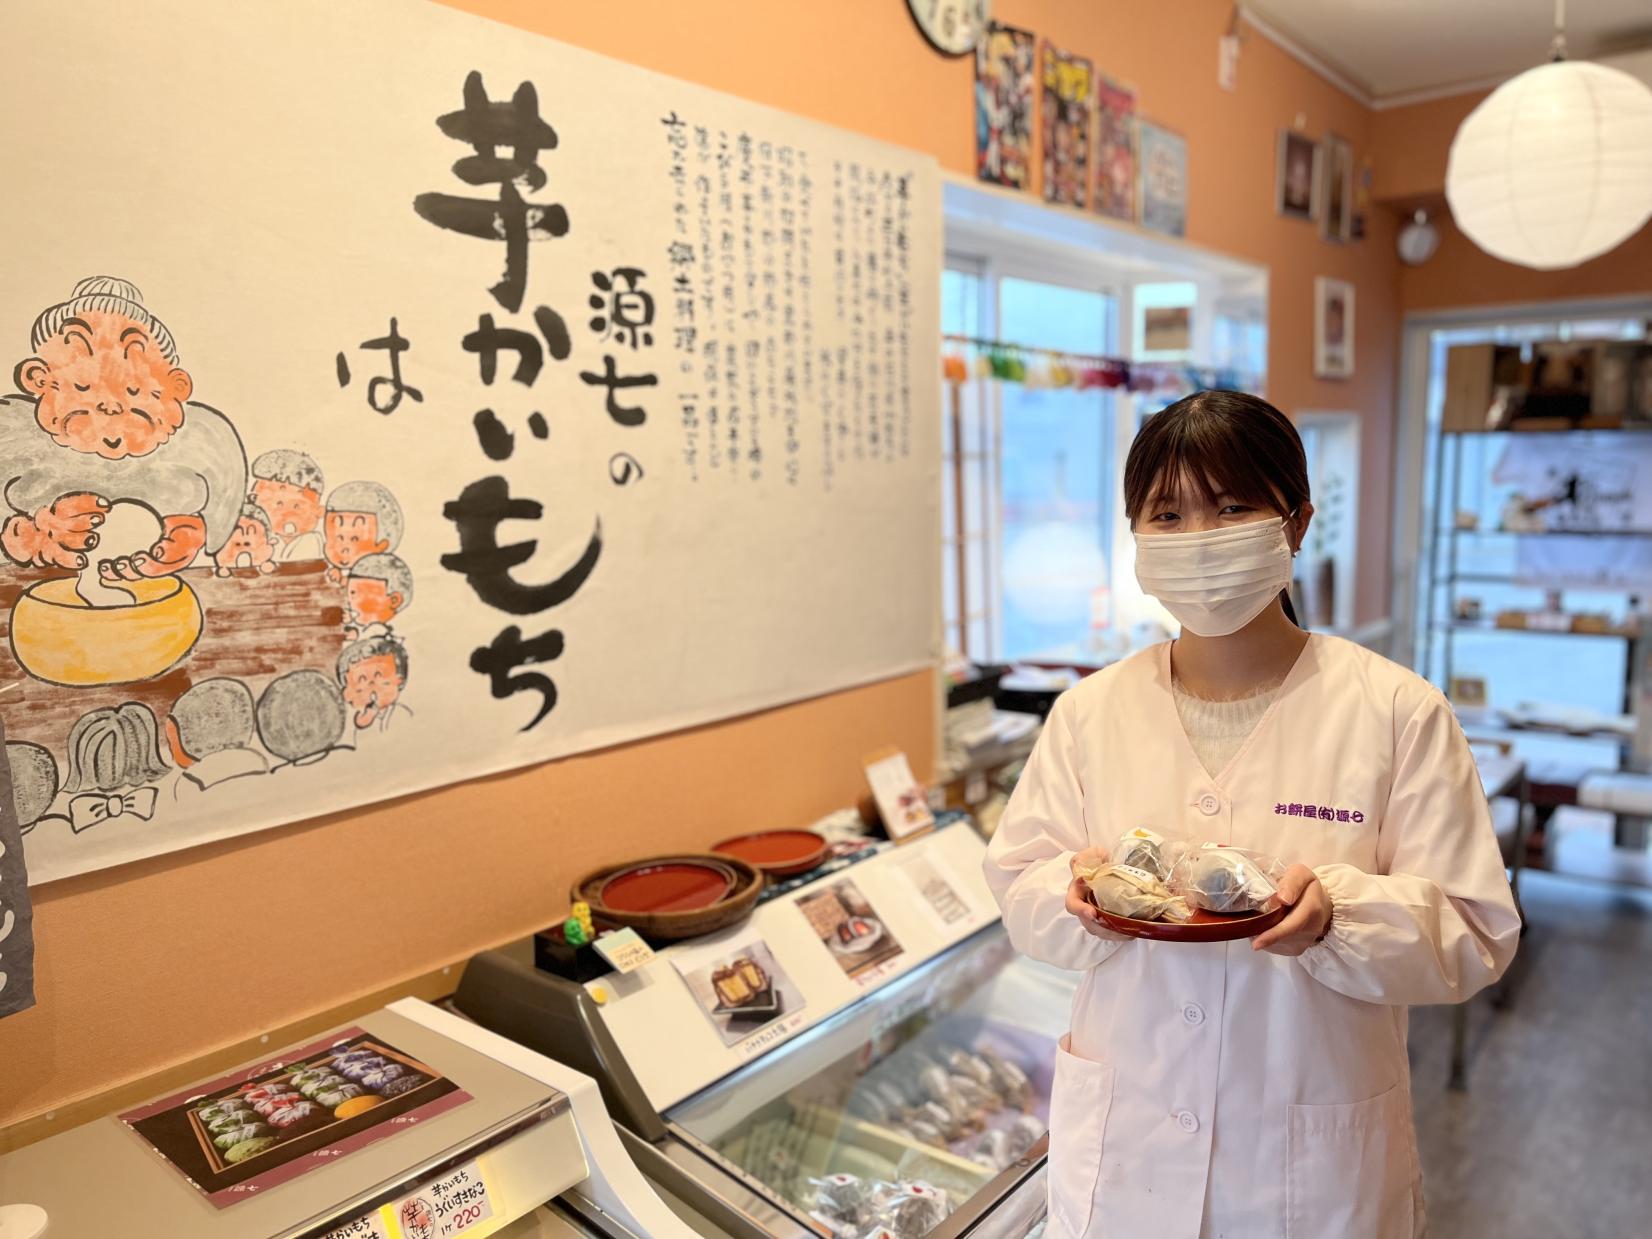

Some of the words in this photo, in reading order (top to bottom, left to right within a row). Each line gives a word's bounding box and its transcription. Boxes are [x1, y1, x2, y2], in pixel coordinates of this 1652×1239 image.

[336, 316, 424, 415] は
[413, 70, 603, 734] 芋かいもち
[579, 267, 658, 486] 源七の
[431, 1170, 469, 1198] 芋かいもち
[435, 1181, 485, 1218] うぐいすきなこ
